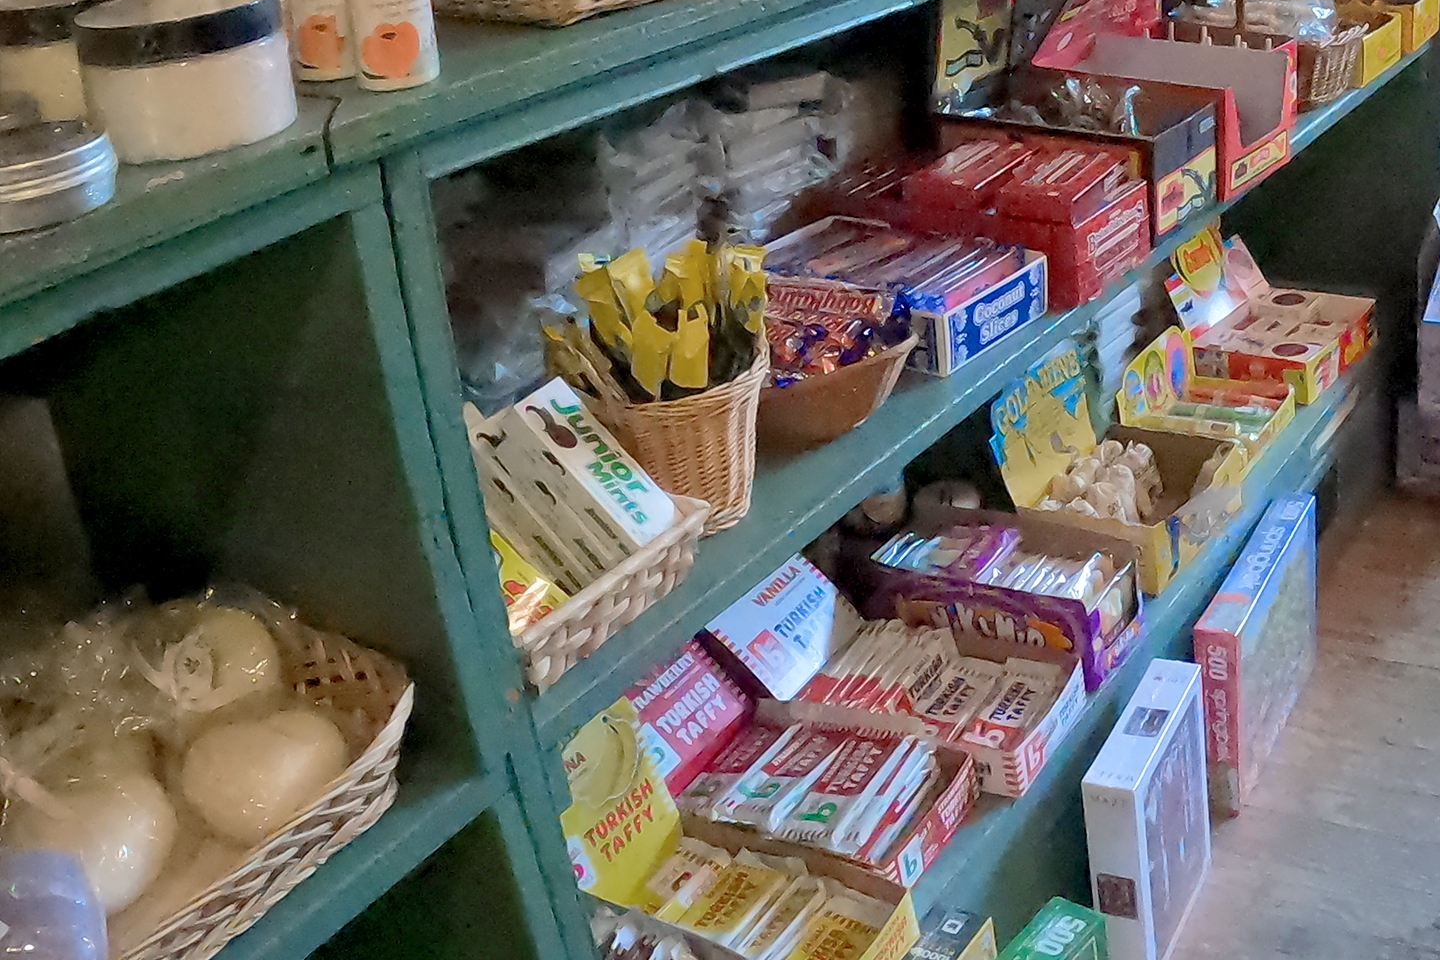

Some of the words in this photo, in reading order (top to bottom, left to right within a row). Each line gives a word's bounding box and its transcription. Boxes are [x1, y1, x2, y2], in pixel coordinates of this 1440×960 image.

[974, 281, 1026, 326] Coconut
[980, 309, 1019, 345] Slices
[550, 398, 648, 494] Junior
[585, 460, 648, 526] Mints
[751, 564, 802, 608] VANILLA
[772, 585, 828, 639] TURKISH
[656, 672, 721, 734] TURKISH
[676, 693, 728, 745] TAFFY
[1006, 688, 1037, 721] TAFFY
[583, 778, 655, 848] TURKISH
[599, 803, 655, 863] TAFFY
[1034, 914, 1087, 956] 500
